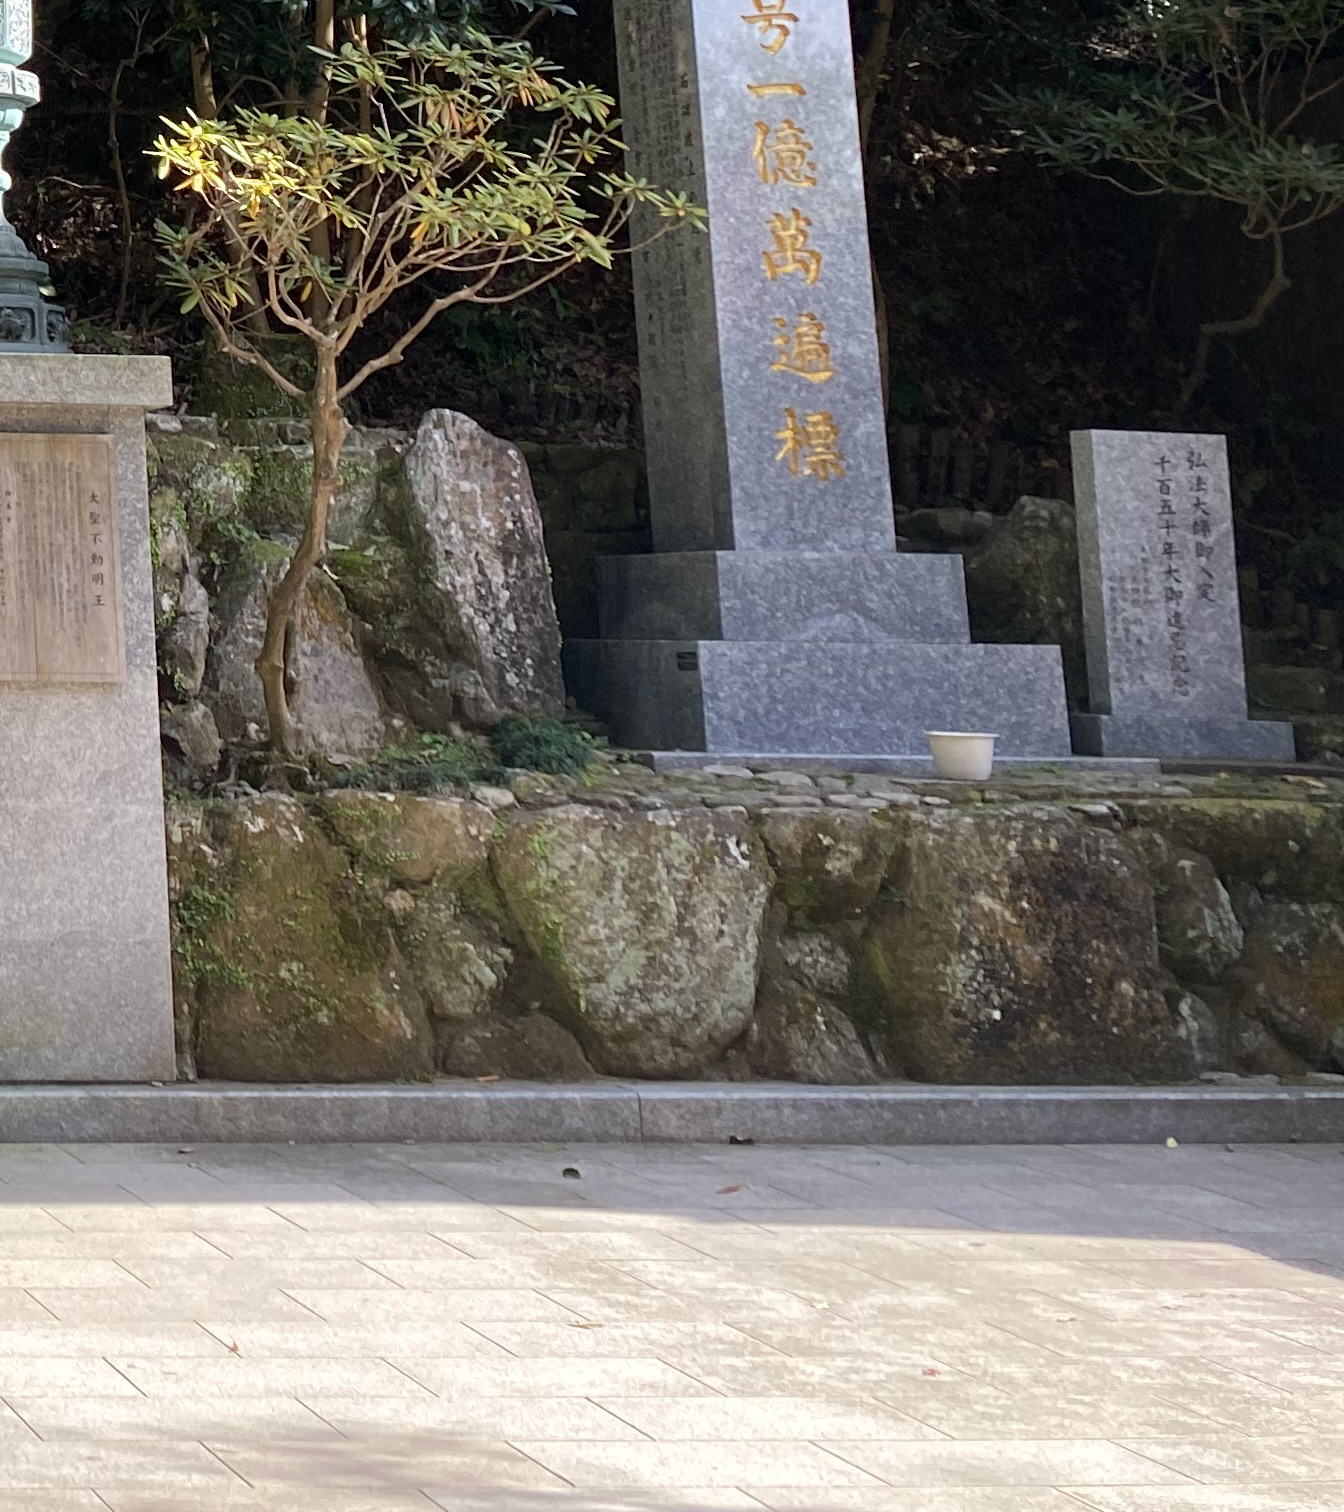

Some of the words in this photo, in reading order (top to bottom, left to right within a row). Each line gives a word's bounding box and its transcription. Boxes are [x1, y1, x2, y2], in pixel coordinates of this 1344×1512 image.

[88, 491, 106, 607] 大聖不動明王
